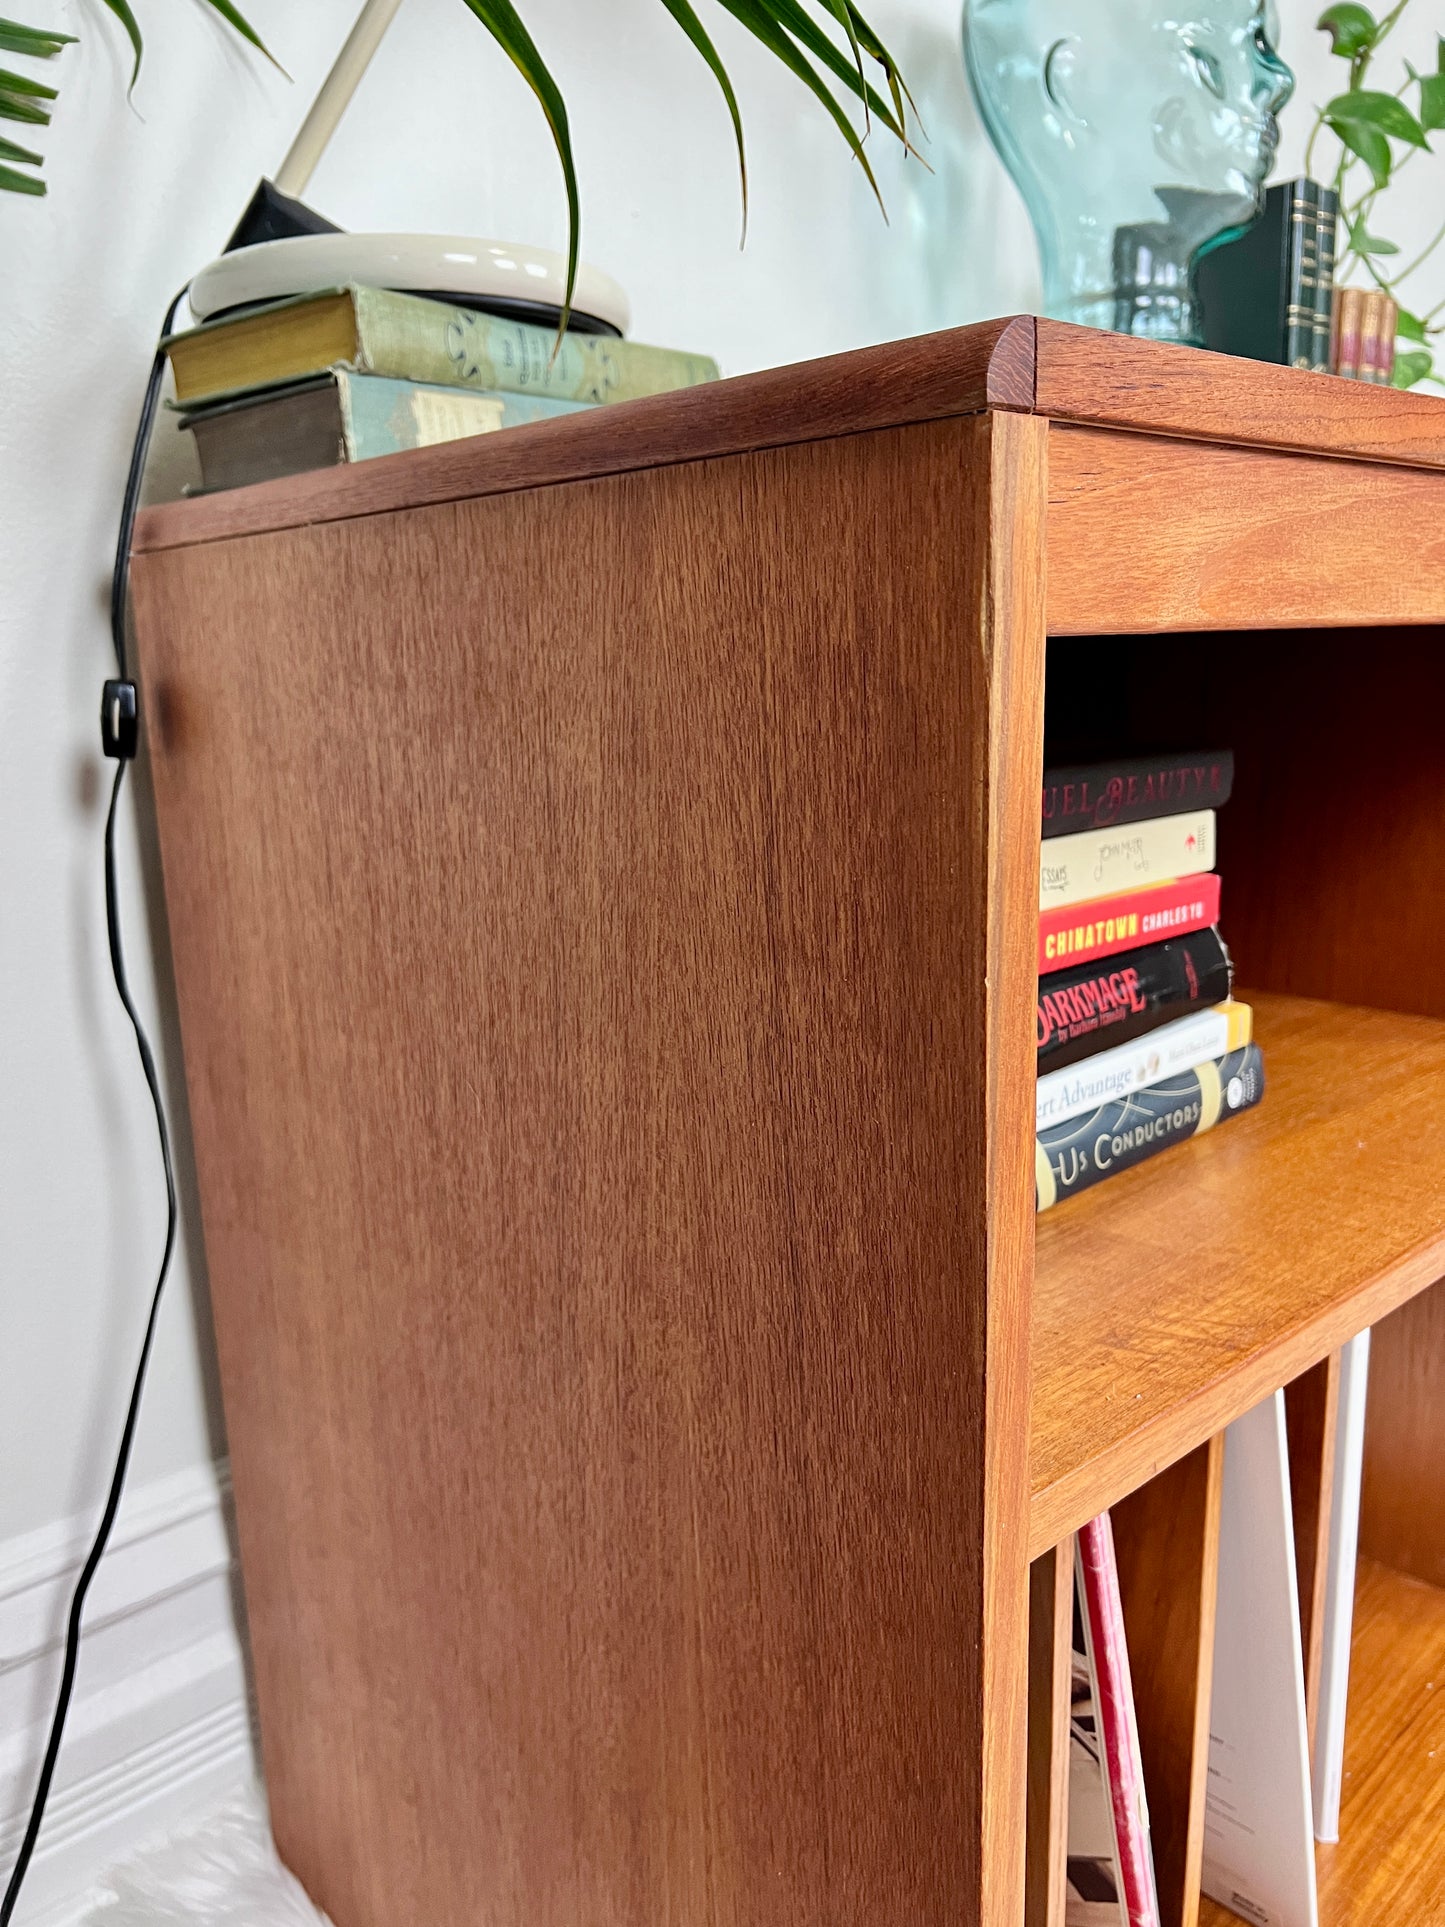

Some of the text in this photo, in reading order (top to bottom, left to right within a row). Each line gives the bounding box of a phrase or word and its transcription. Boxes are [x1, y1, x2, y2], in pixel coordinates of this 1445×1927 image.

[1098, 766, 1206, 822] BEAUTY
[1045, 901, 1203, 959] CHINATOWN CHARLES YU
[1058, 1068, 1132, 1110] Advantage
